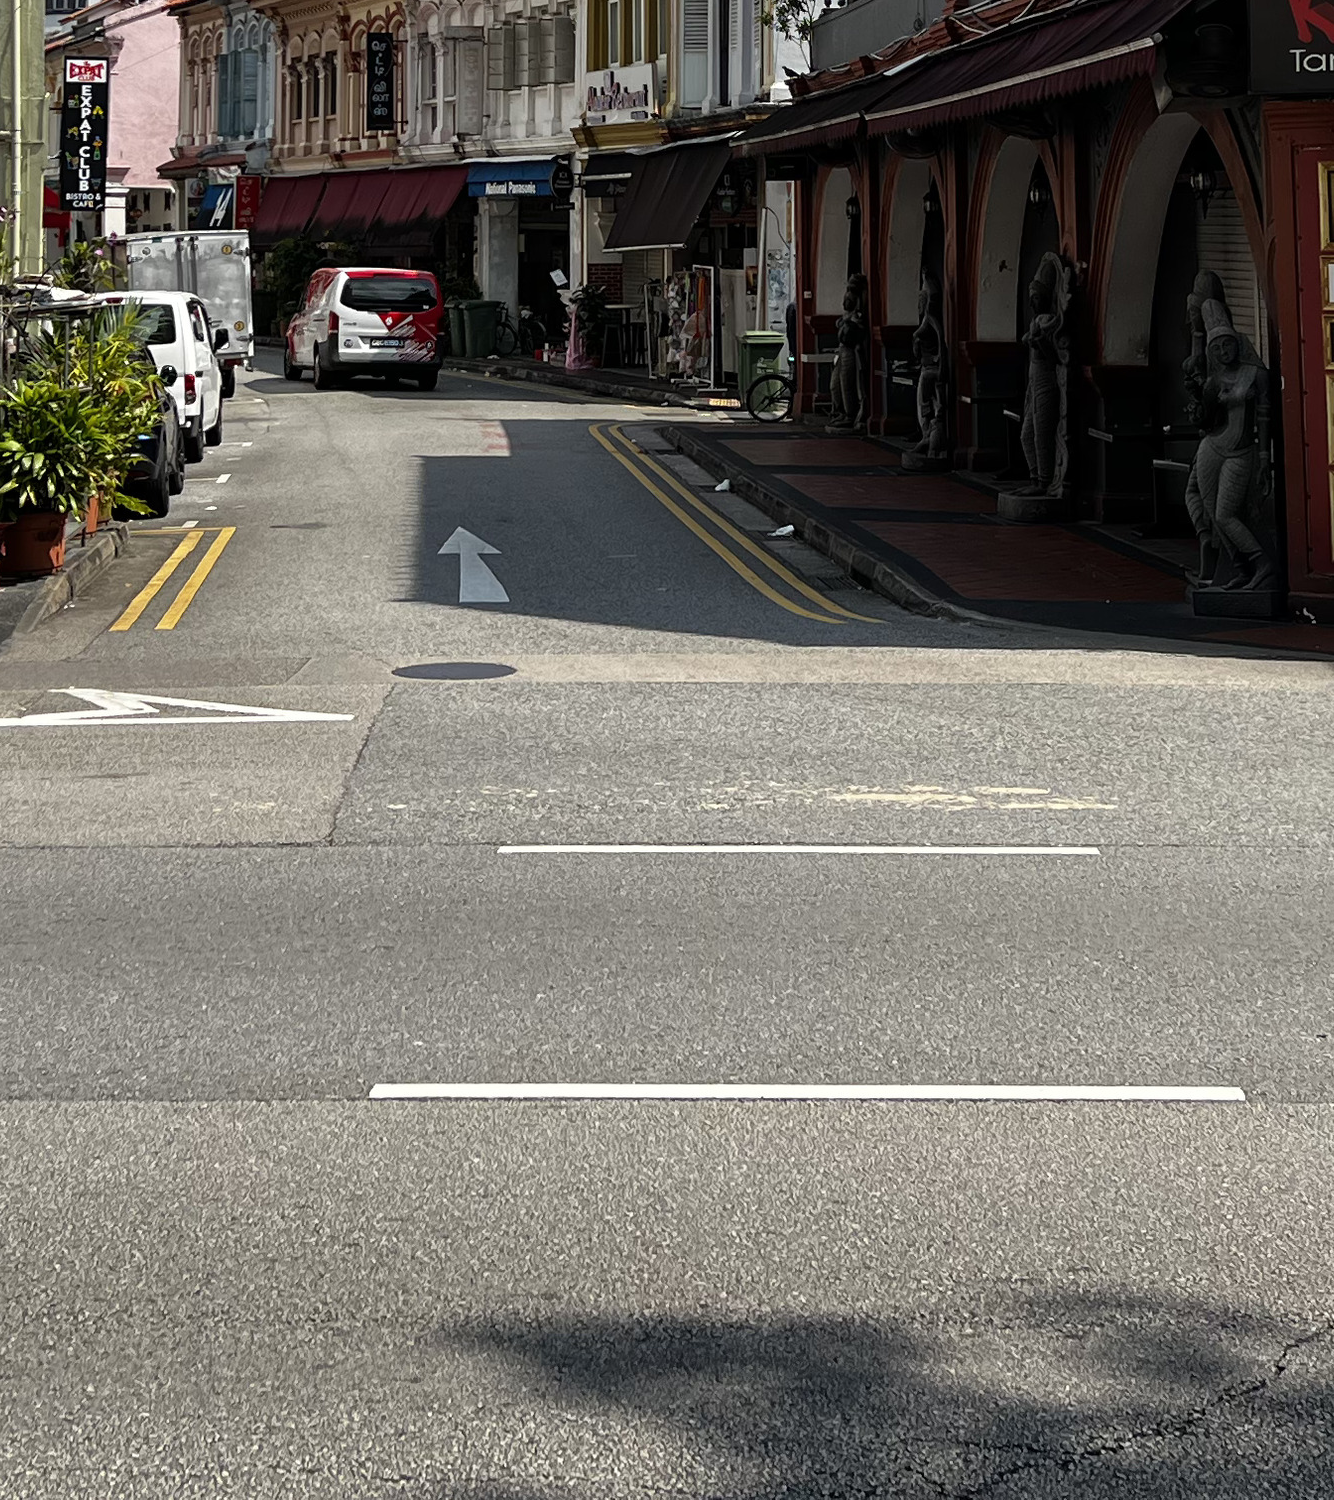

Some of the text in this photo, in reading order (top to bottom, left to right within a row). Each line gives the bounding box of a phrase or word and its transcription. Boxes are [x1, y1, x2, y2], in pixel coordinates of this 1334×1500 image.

[69, 63, 105, 79] EXPAT
[78, 85, 92, 192] EXPAT CLUB
[485, 181, 536, 196] National Panasonic
[66, 193, 94, 201] BISTRO
